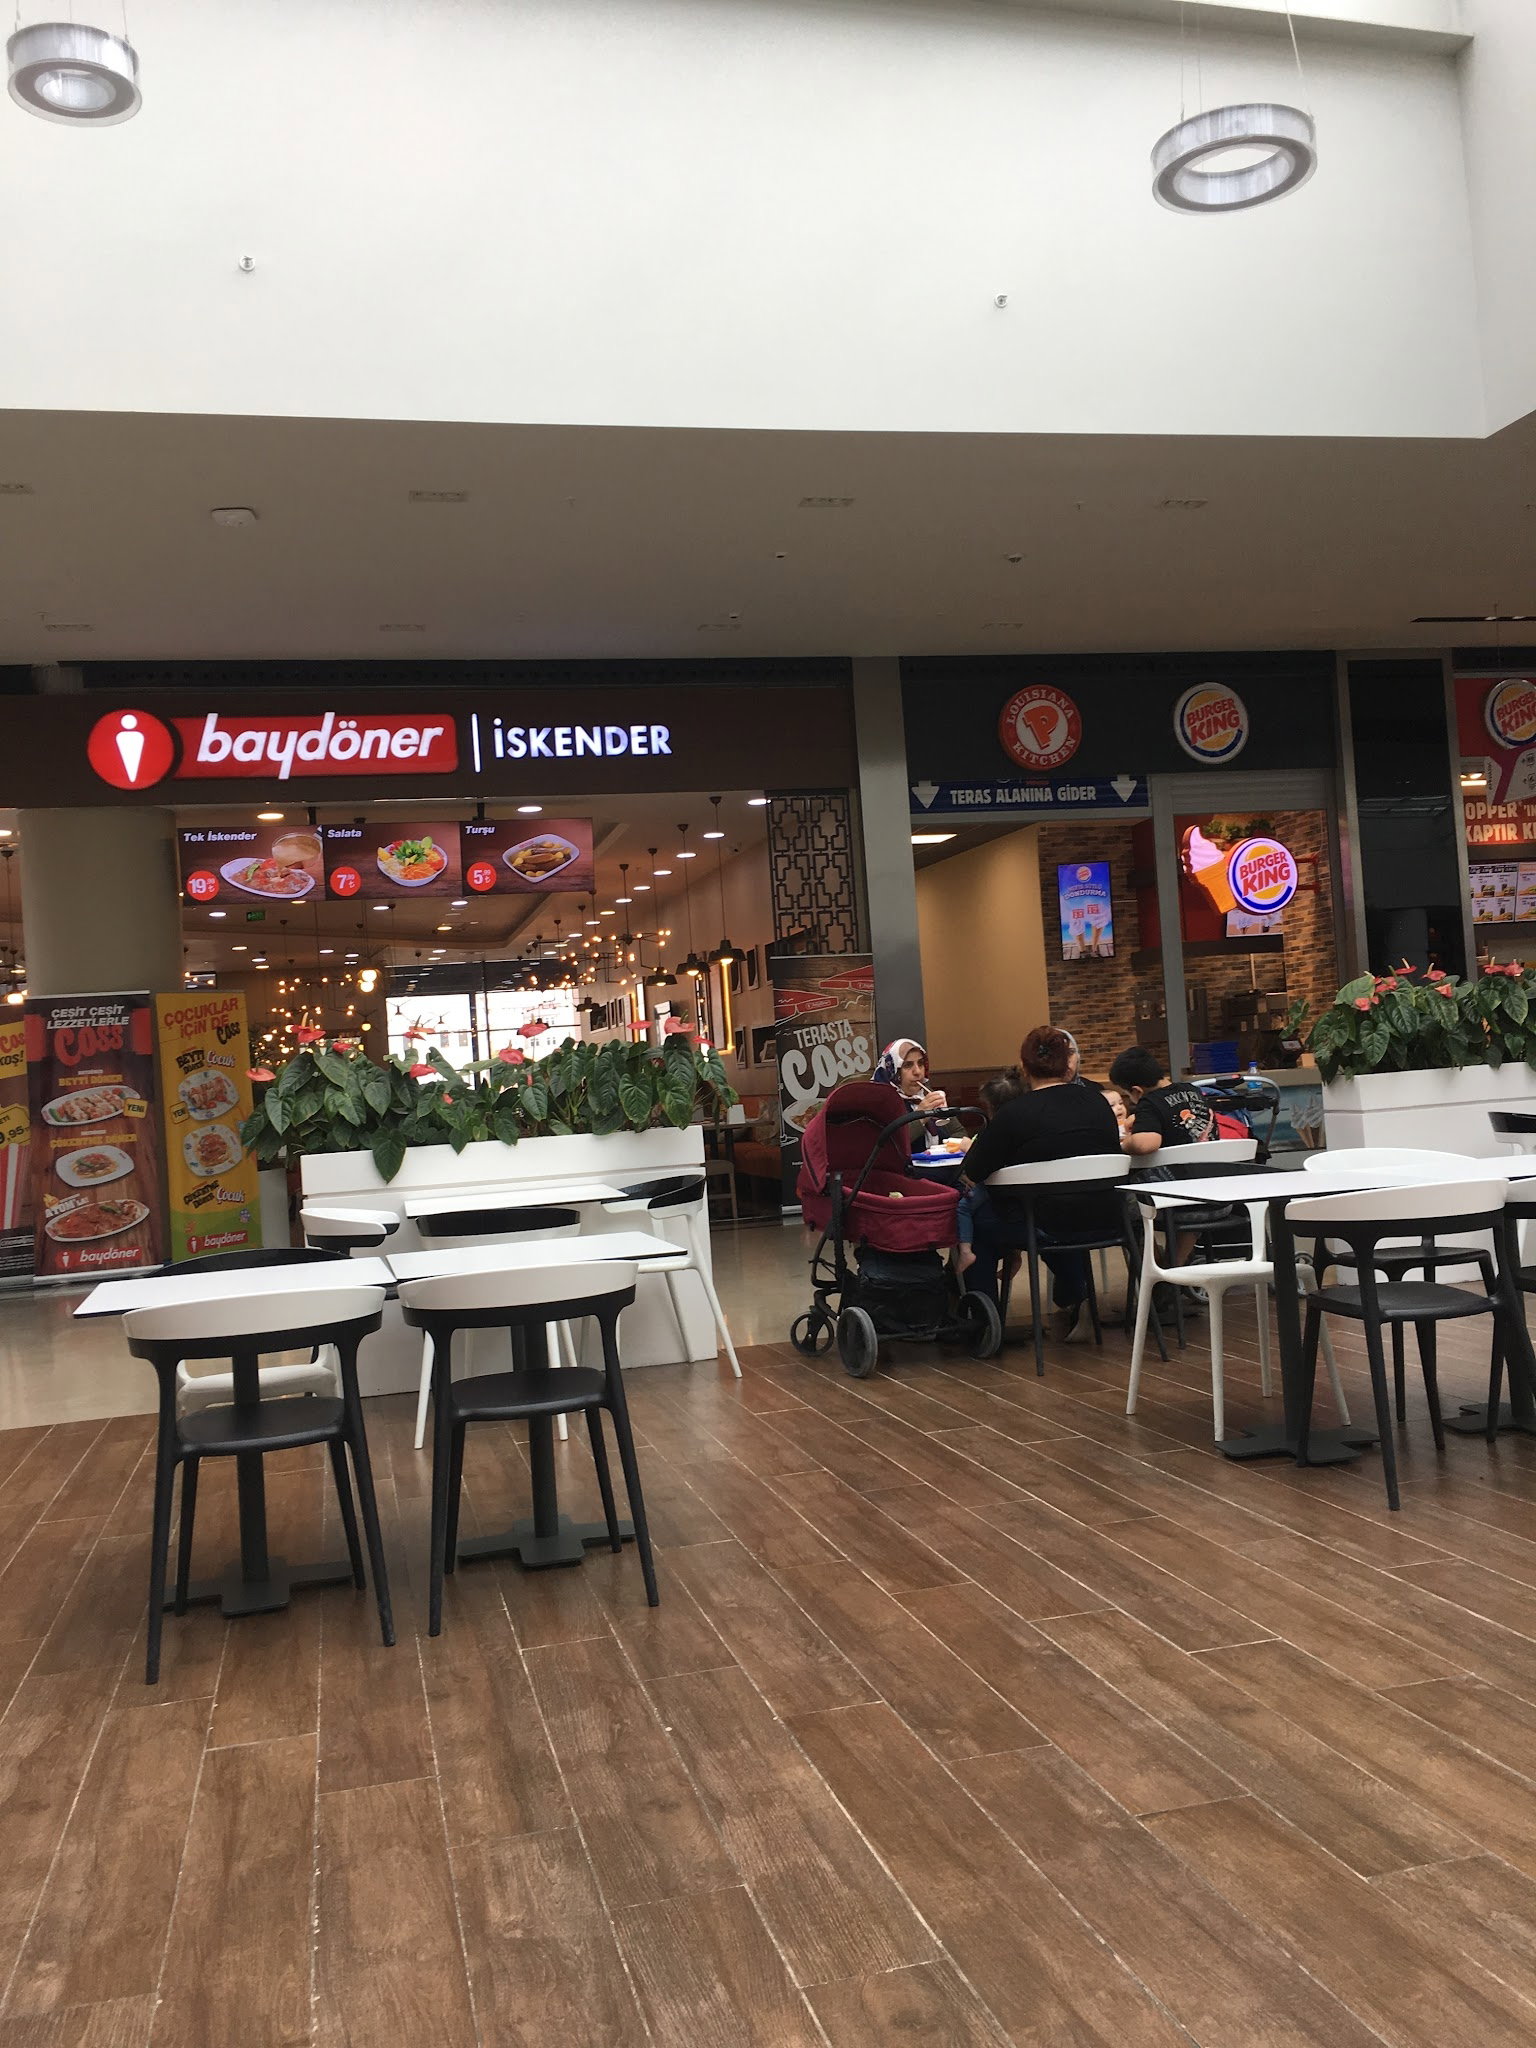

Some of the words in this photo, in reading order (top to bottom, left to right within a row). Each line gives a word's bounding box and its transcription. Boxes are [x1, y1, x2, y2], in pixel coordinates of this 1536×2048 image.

[1006, 689, 1074, 725] LOUISIANA
[1186, 698, 1236, 727] BURGER
[493, 717, 672, 759] İSKENDER
[1190, 709, 1240, 745] KING
[197, 711, 444, 780] baydöner
[1013, 735, 1075, 766] KITCHEN
[950, 789, 991, 805] TERAS
[995, 786, 1053, 804] ALANINA
[1057, 784, 1097, 801] GİDER
[183, 832, 205, 842] Tek
[207, 830, 257, 842] İskender
[327, 828, 362, 838] Salata
[465, 825, 495, 836] Turşu
[1240, 851, 1288, 880] BURGER
[1242, 862, 1291, 897] KING
[46, 1016, 130, 1030] LEZZETLERLE
[51, 1006, 87, 1019] ÇEŞİT
[89, 1004, 125, 1017] ÇEŞİT
[163, 997, 239, 1031] ÇOCUKLAR
[211, 1014, 229, 1030] DE
[793, 1018, 854, 1049] TERASTA
[204, 1231, 246, 1248] baydöner
[80, 1247, 139, 1265] baydöner
